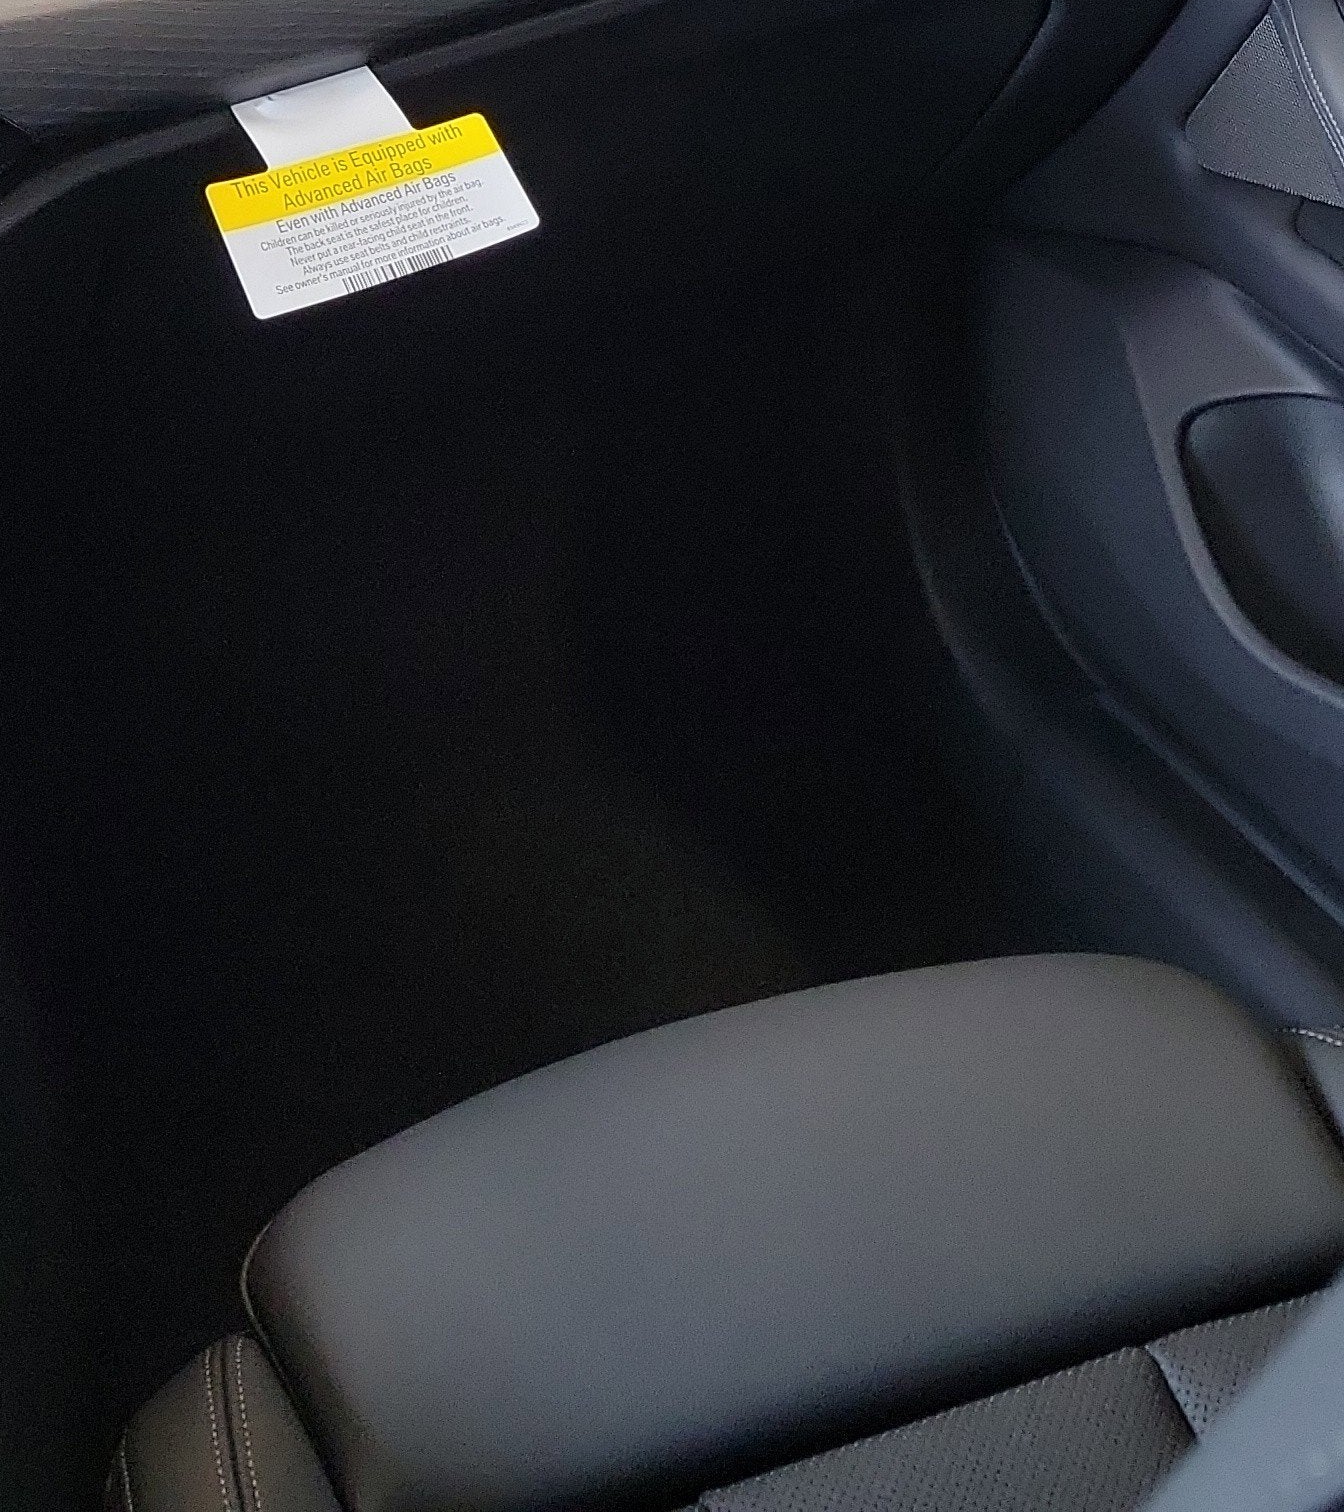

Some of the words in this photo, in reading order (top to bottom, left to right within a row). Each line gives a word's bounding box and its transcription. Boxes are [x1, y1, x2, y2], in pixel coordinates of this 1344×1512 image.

[230, 178, 269, 198] This
[268, 162, 331, 189] Vehicle
[331, 157, 348, 173] is
[348, 134, 426, 167] Equipped
[427, 124, 463, 145] with
[284, 174, 363, 210] Advanced
[366, 167, 388, 187] Air
[389, 158, 432, 179] Bags
[276, 216, 310, 234] Even
[310, 206, 339, 224] with
[340, 186, 402, 215] Advanced
[404, 181, 421, 197] Air
[421, 172, 456, 190] Bags
